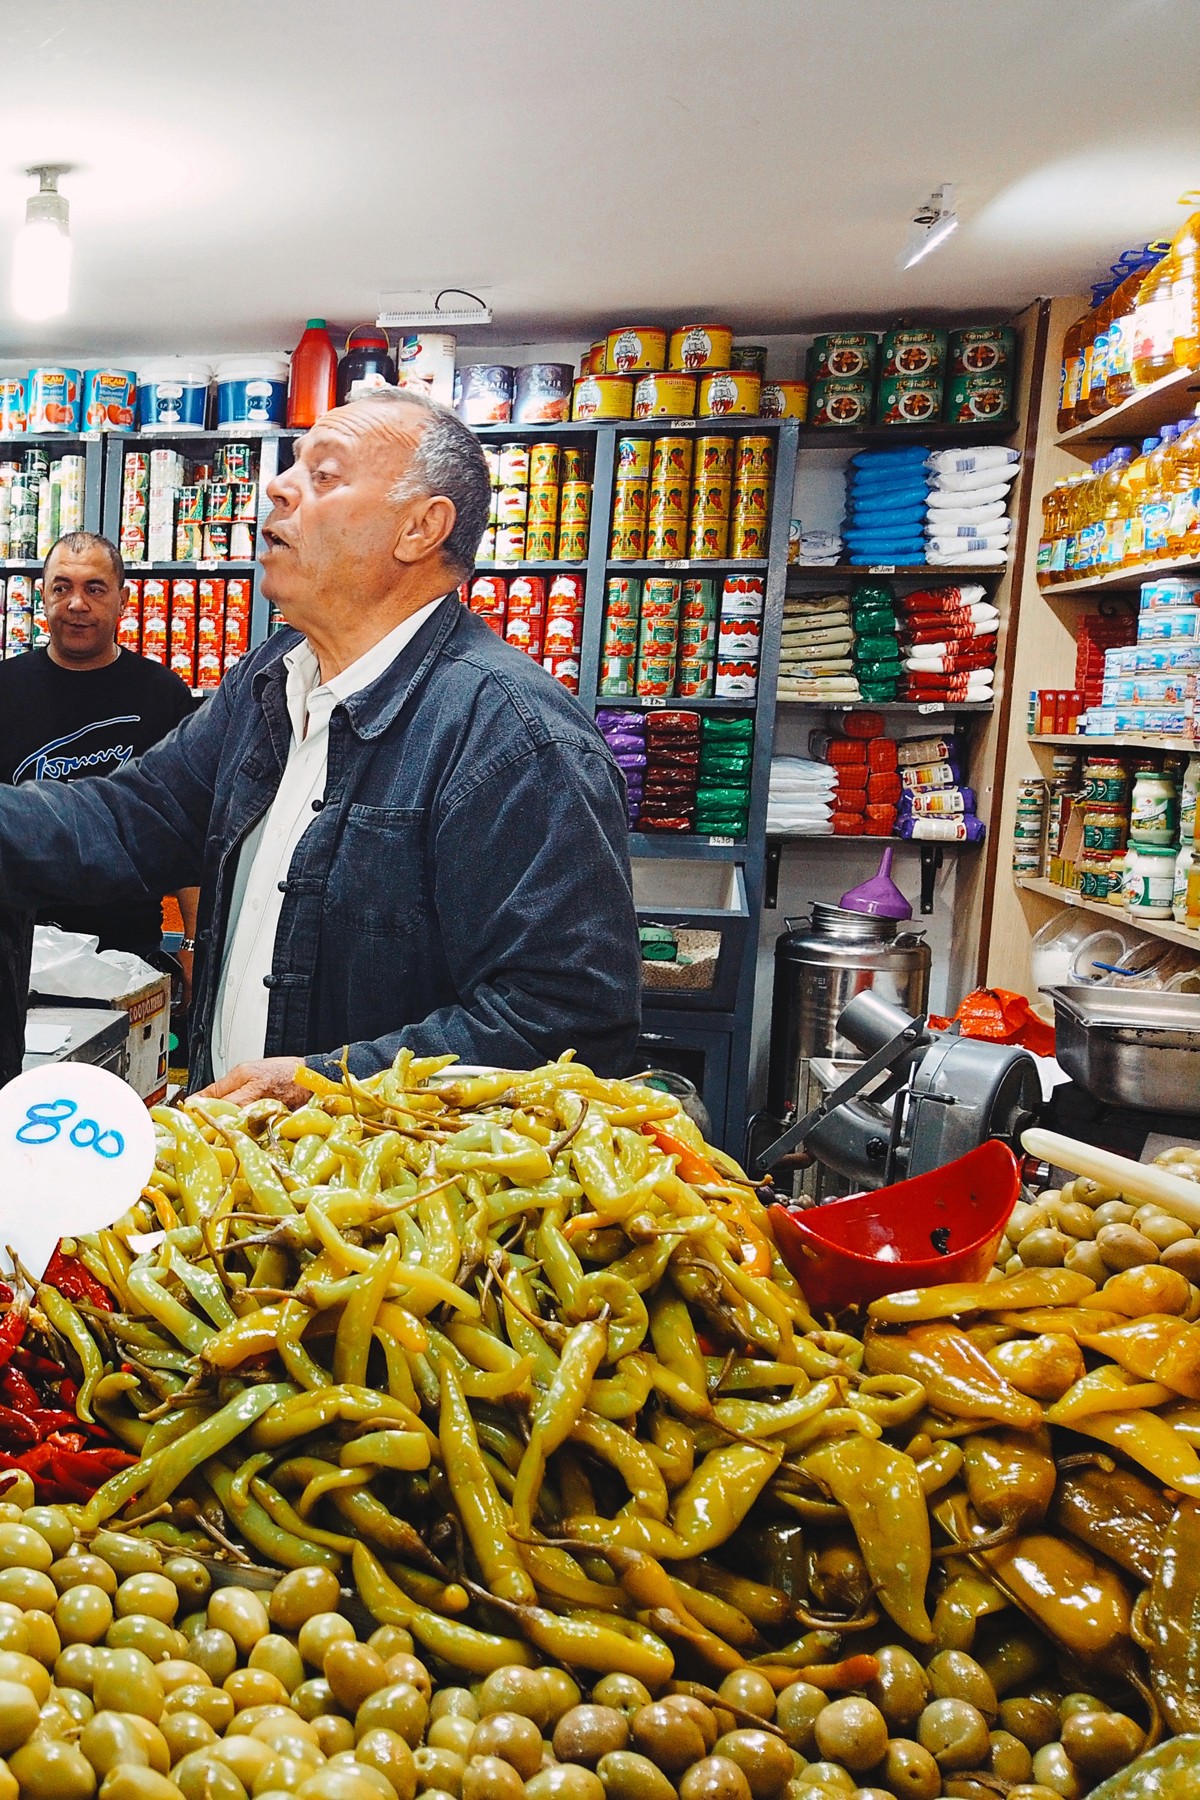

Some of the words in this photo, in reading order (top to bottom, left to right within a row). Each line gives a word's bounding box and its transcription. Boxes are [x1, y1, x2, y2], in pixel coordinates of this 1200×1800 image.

[101, 376, 126, 385] SICAM
[12, 715, 140, 785] Tommy
[16, 1099, 124, 1158] 800
